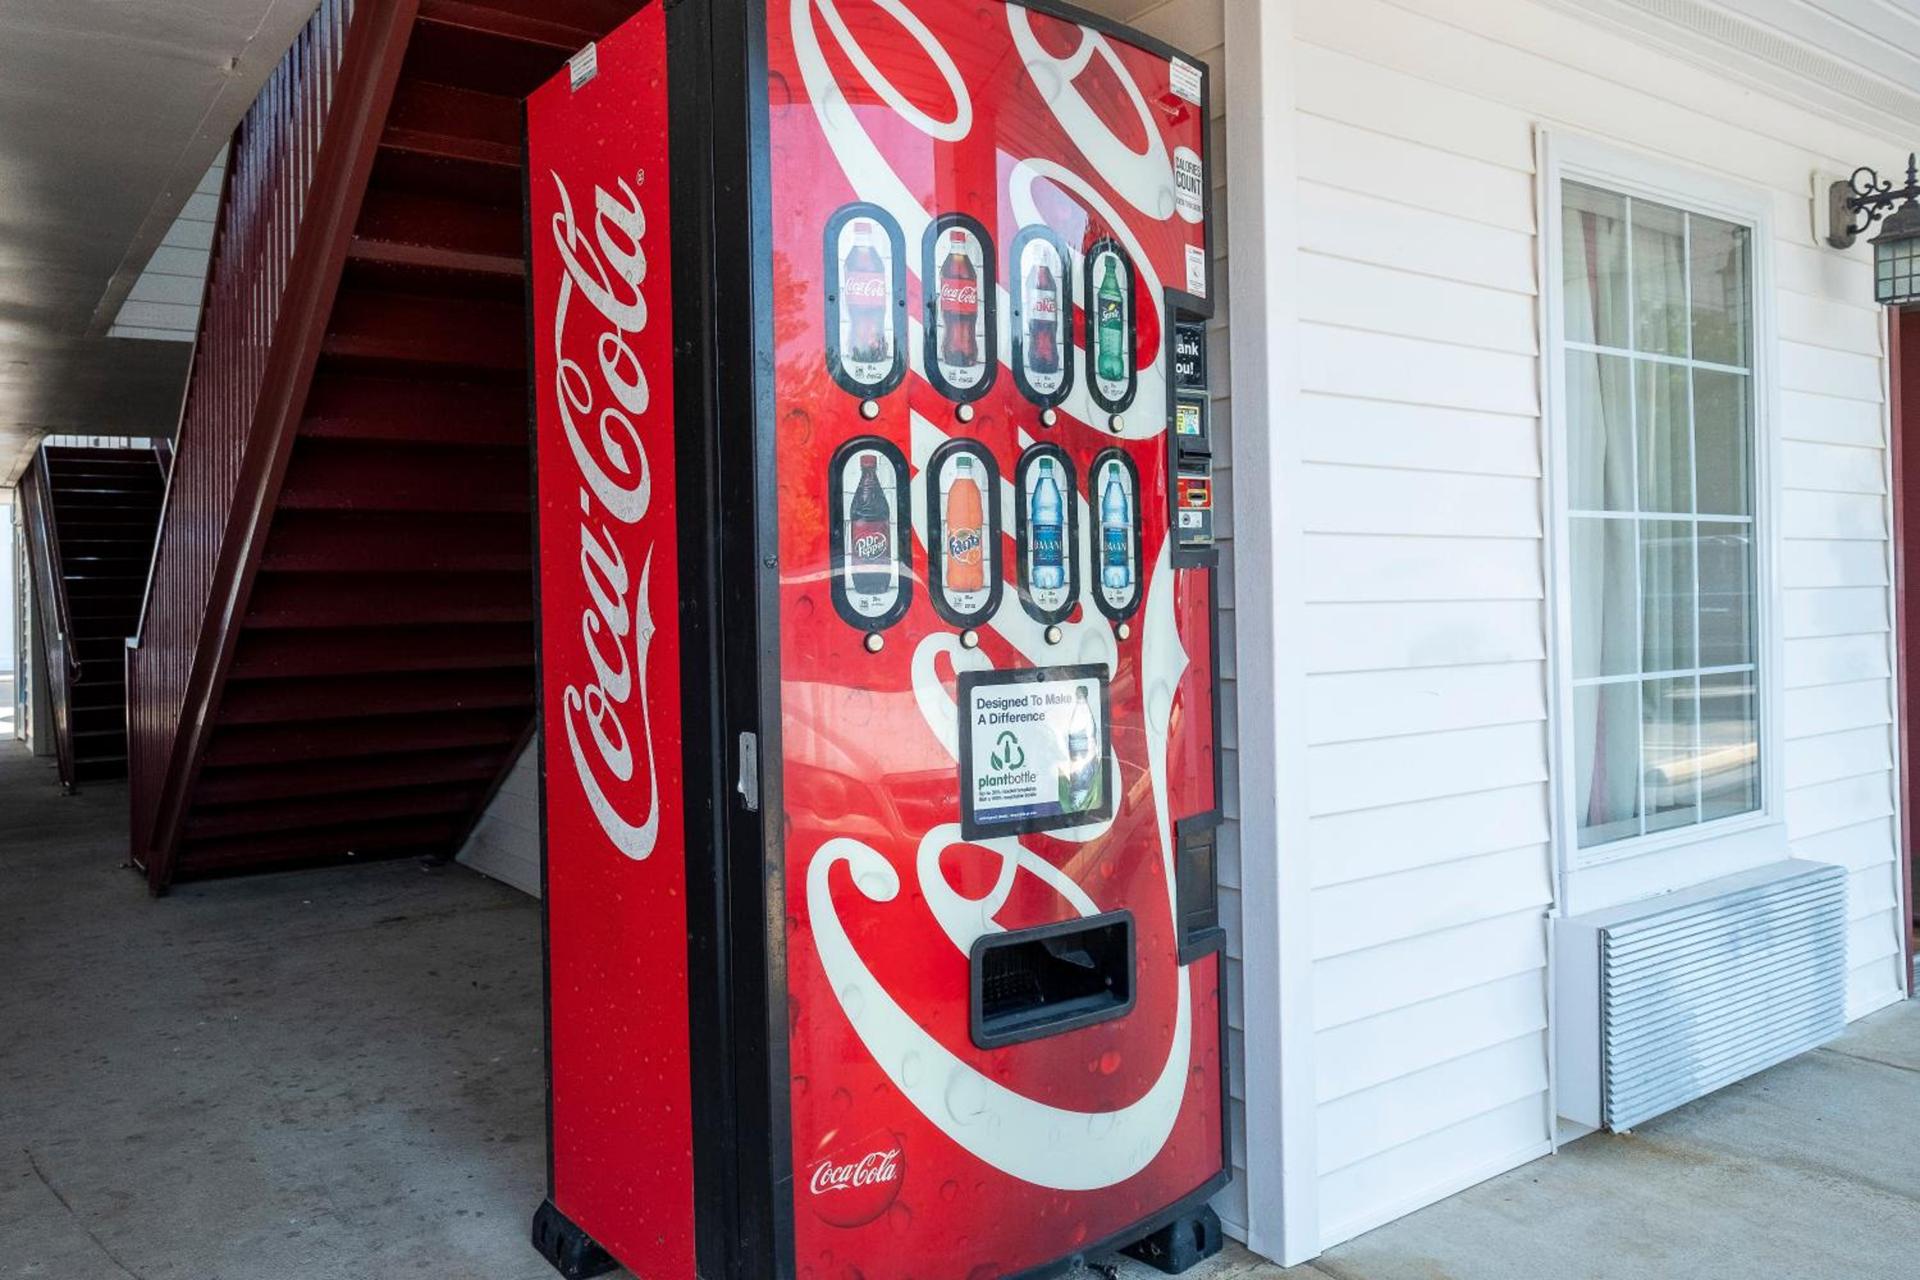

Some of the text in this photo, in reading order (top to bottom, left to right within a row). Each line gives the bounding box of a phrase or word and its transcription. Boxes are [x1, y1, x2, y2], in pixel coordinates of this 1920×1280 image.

[1175, 170, 1201, 196] COUNT
[1176, 342, 1199, 356] ank
[1175, 361, 1194, 375] ou!
[550, 168, 660, 862] Coca-Cola
[950, 534, 980, 556] Fanta
[976, 693, 1073, 711] Designed To Make
[978, 712, 1046, 725] A Difference
[810, 1149, 901, 1195] Coca-Cola
